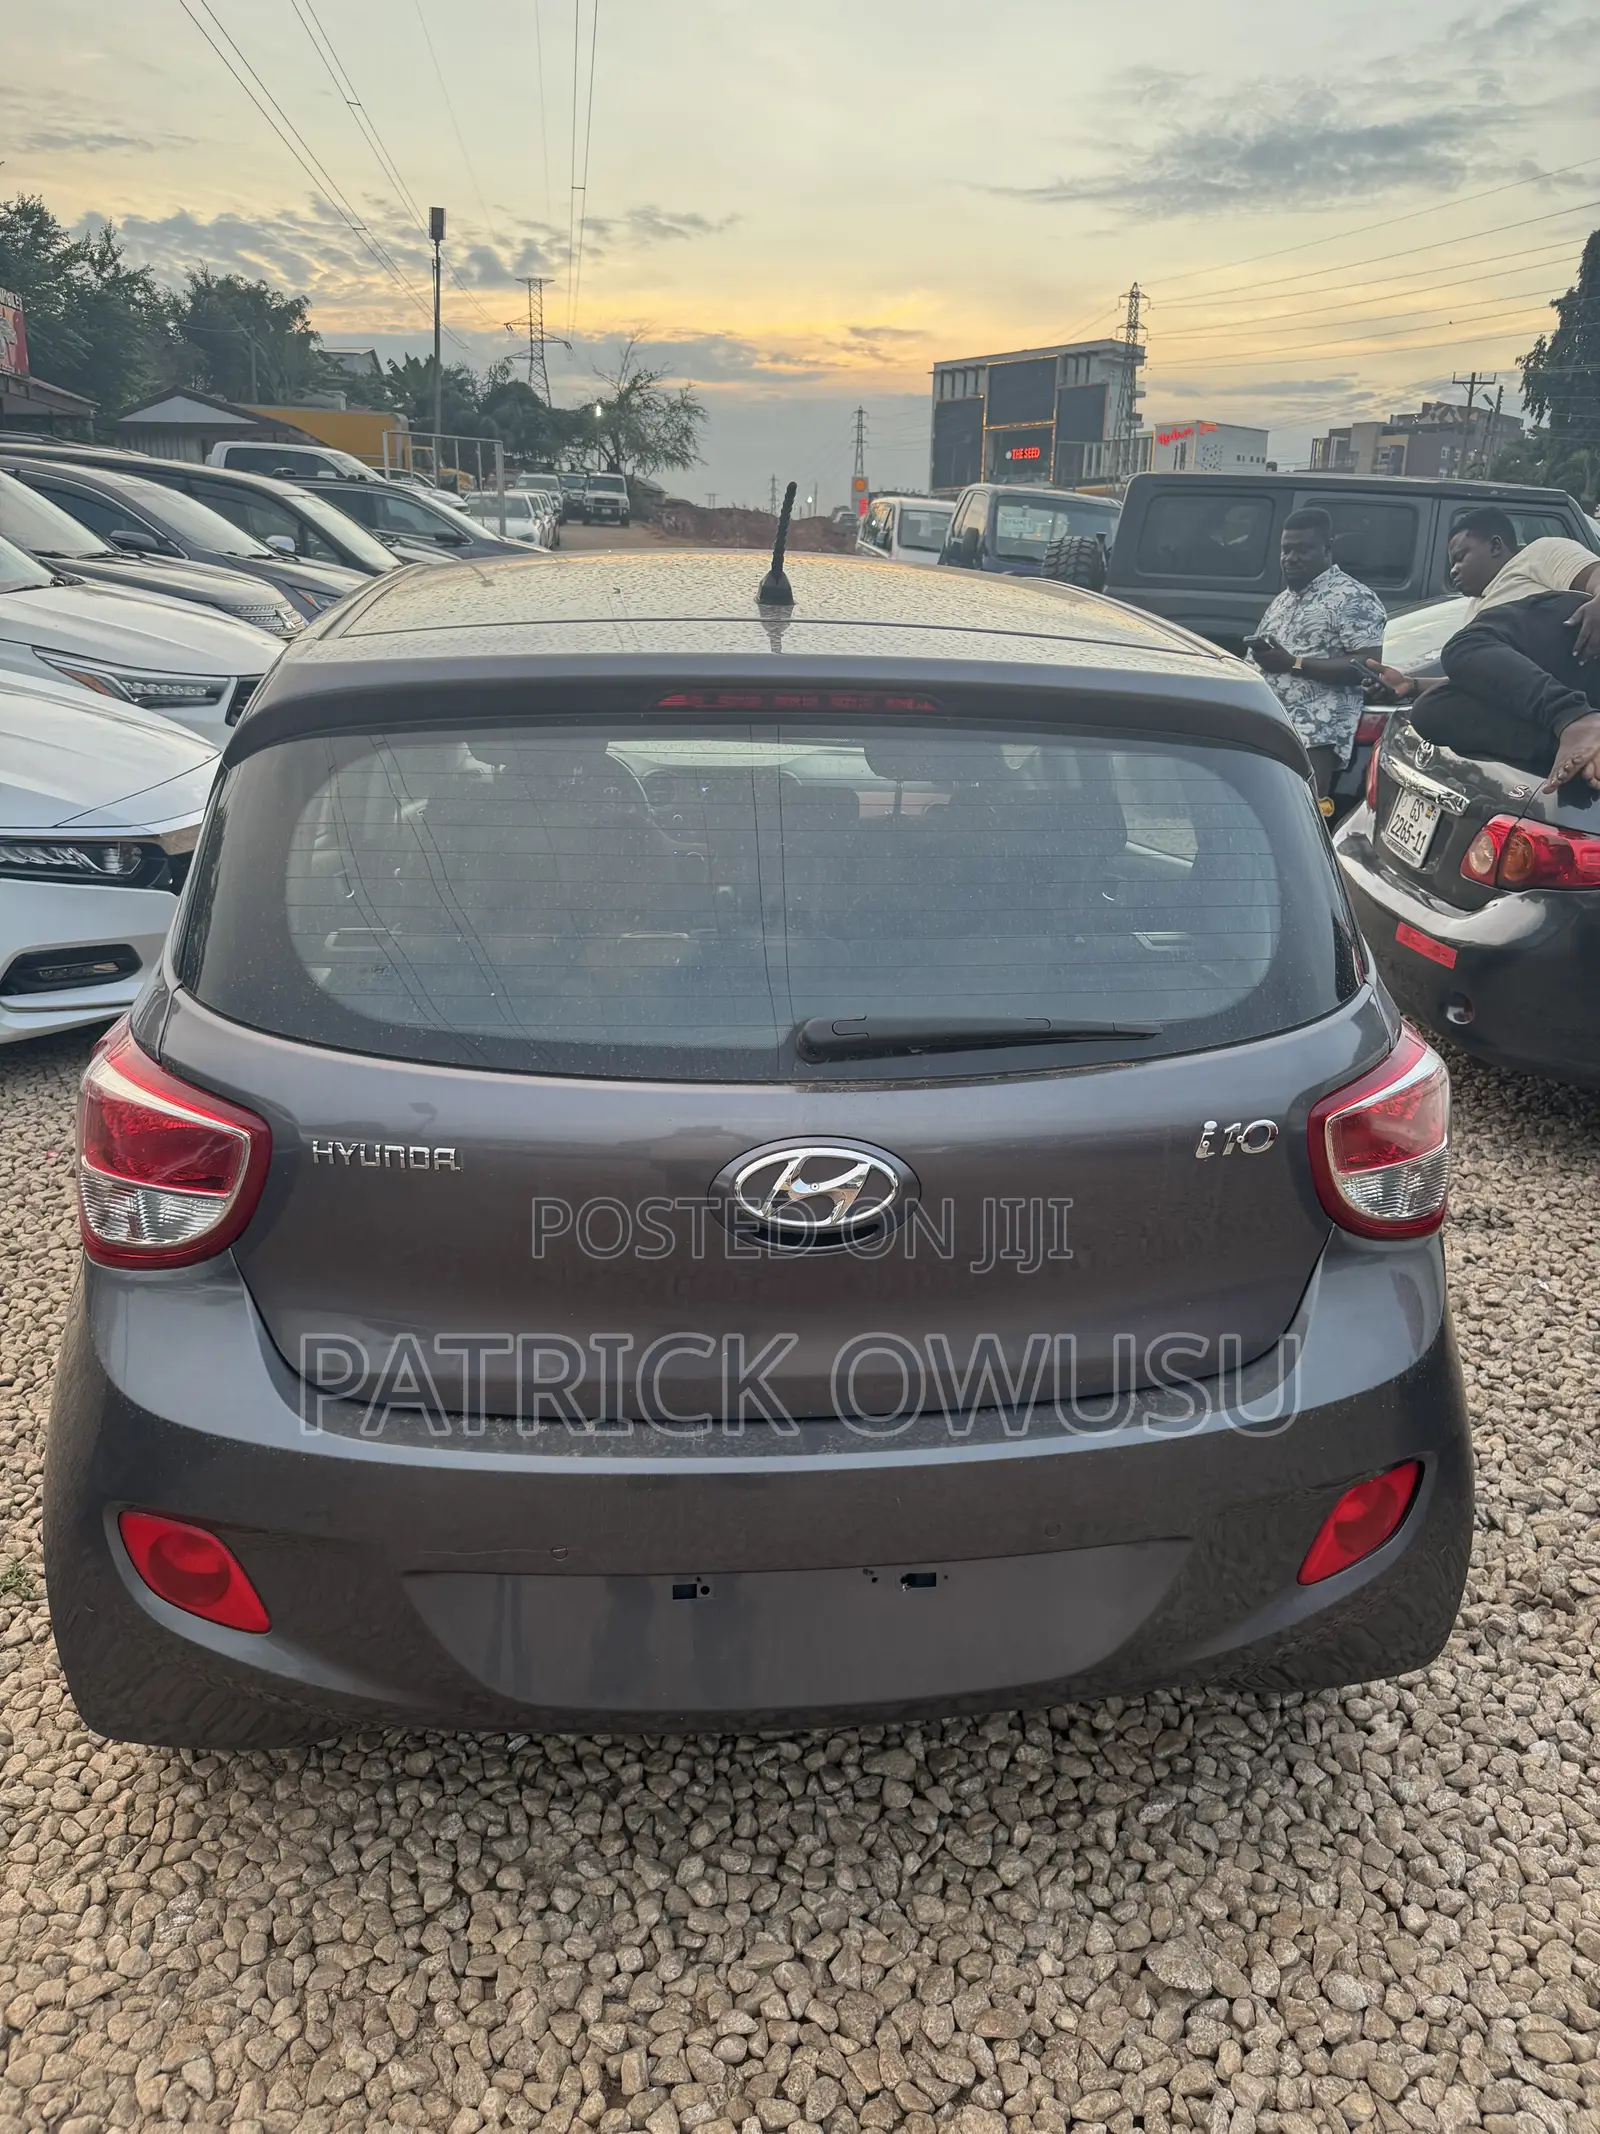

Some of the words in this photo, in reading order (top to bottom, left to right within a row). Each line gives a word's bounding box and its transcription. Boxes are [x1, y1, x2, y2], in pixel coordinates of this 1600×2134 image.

[1012, 448, 1023, 459] THE
[1410, 798, 1425, 822] GS
[1390, 813, 1427, 855] 2265-11
[1195, 1119, 1279, 1159] i10
